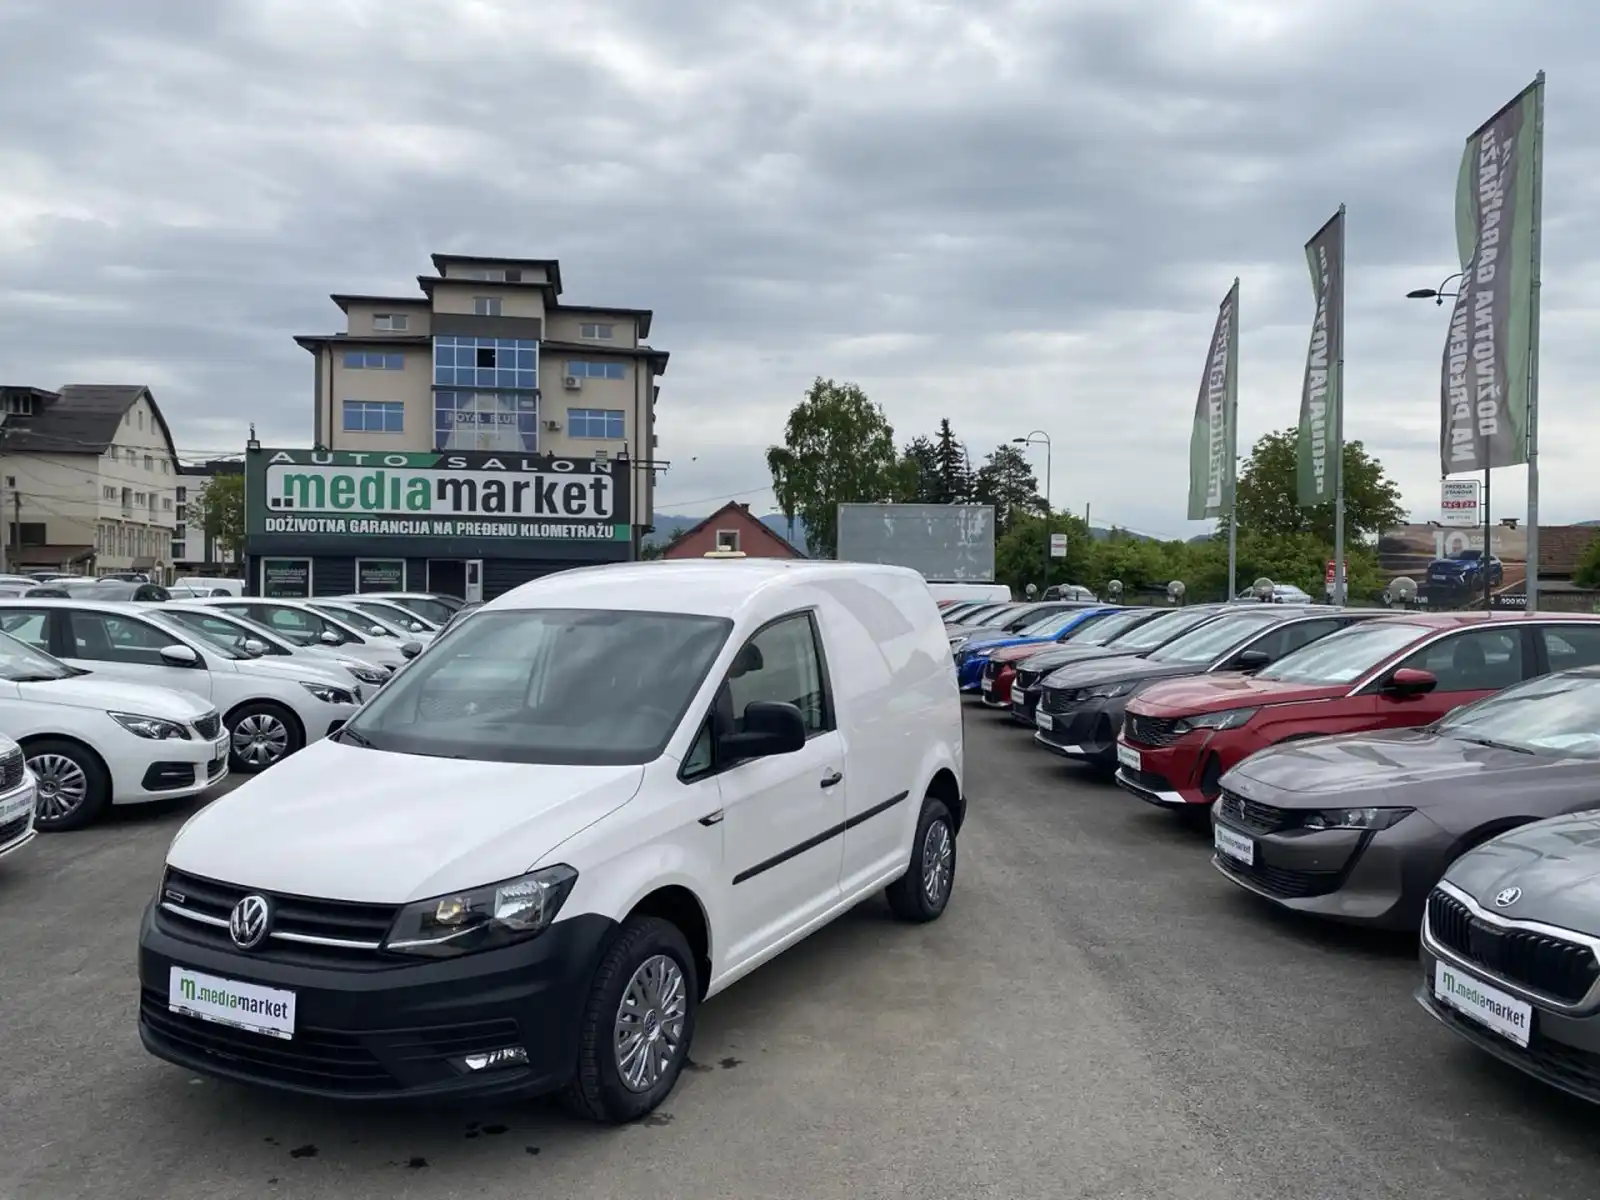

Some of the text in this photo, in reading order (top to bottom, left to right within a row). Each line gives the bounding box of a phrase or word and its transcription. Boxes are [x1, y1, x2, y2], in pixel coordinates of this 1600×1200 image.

[269, 451, 613, 474] AUTO SALON
[265, 515, 614, 538] DOŽIVOTNA GARANCIJA NA PREĐENU KILOMETRAŽU
[1433, 531, 1470, 560] 10
